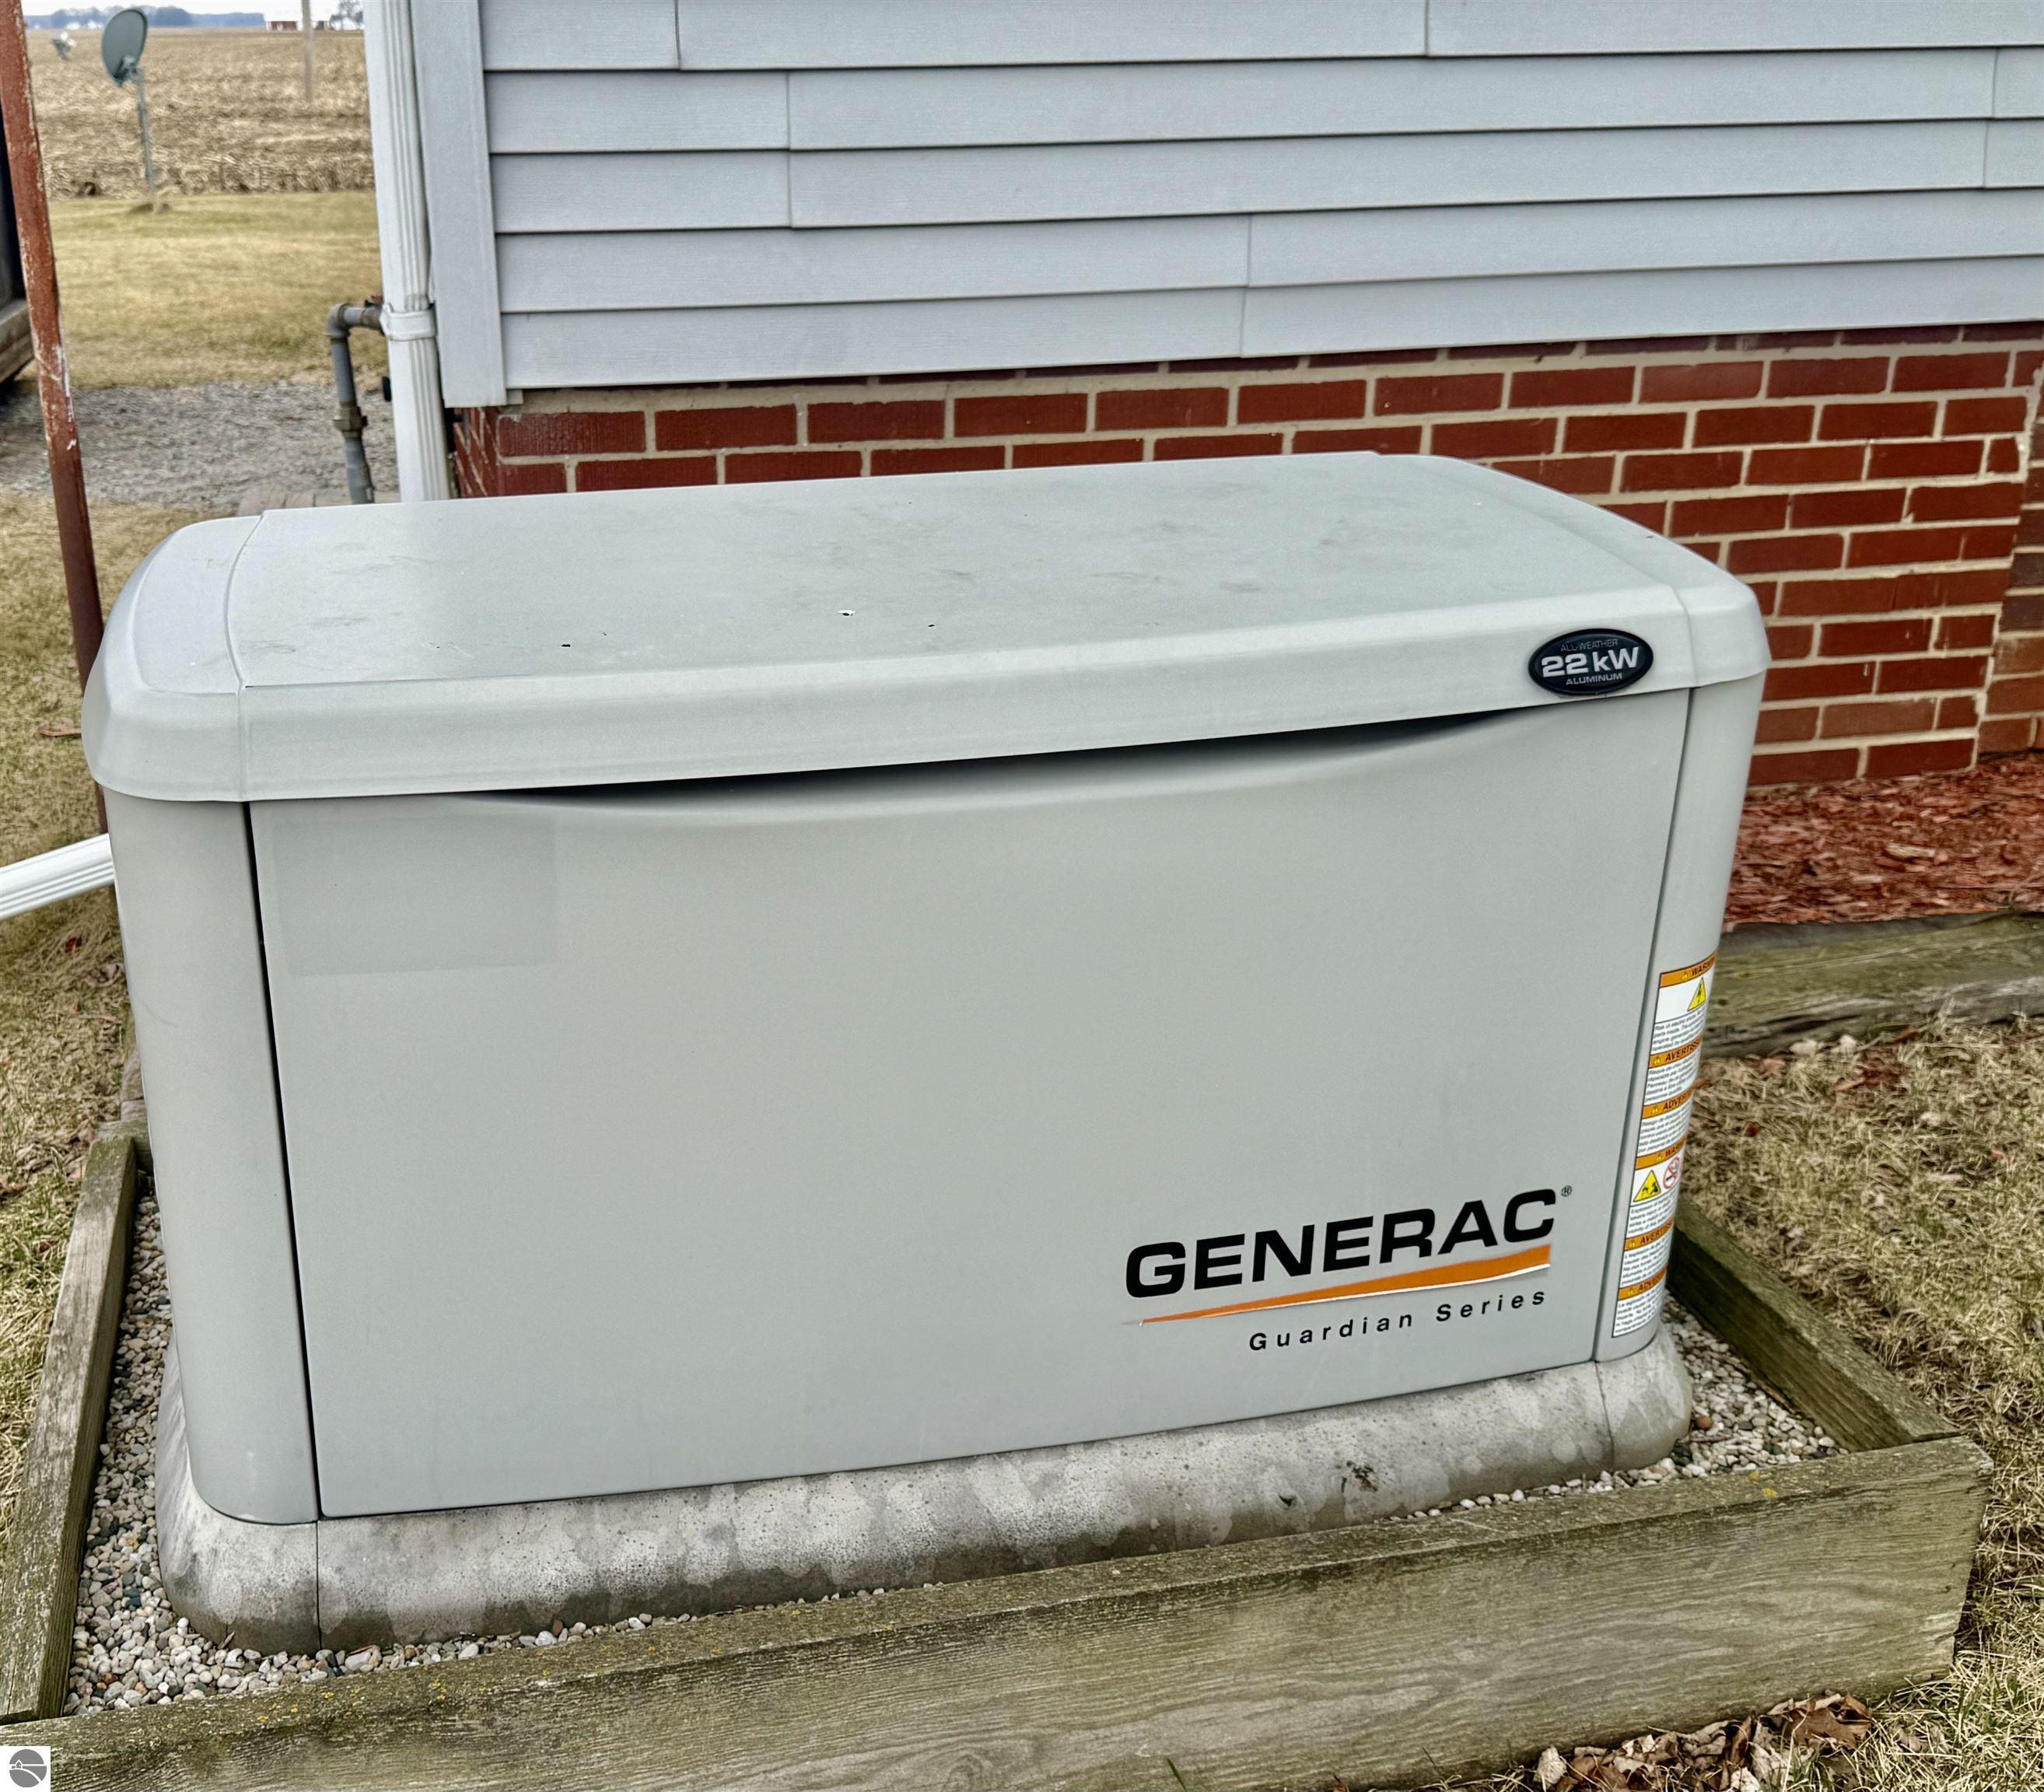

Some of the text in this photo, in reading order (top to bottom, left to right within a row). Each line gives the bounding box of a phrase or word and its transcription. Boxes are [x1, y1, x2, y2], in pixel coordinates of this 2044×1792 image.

[1560, 639, 1619, 652] ALL-WEATHER
[1541, 646, 1640, 677] 22 kW
[1565, 673, 1623, 685] ALUMINUM
[1125, 1188, 1556, 1298] GENERAC
[1248, 1290, 1546, 1351] Guardian Series
